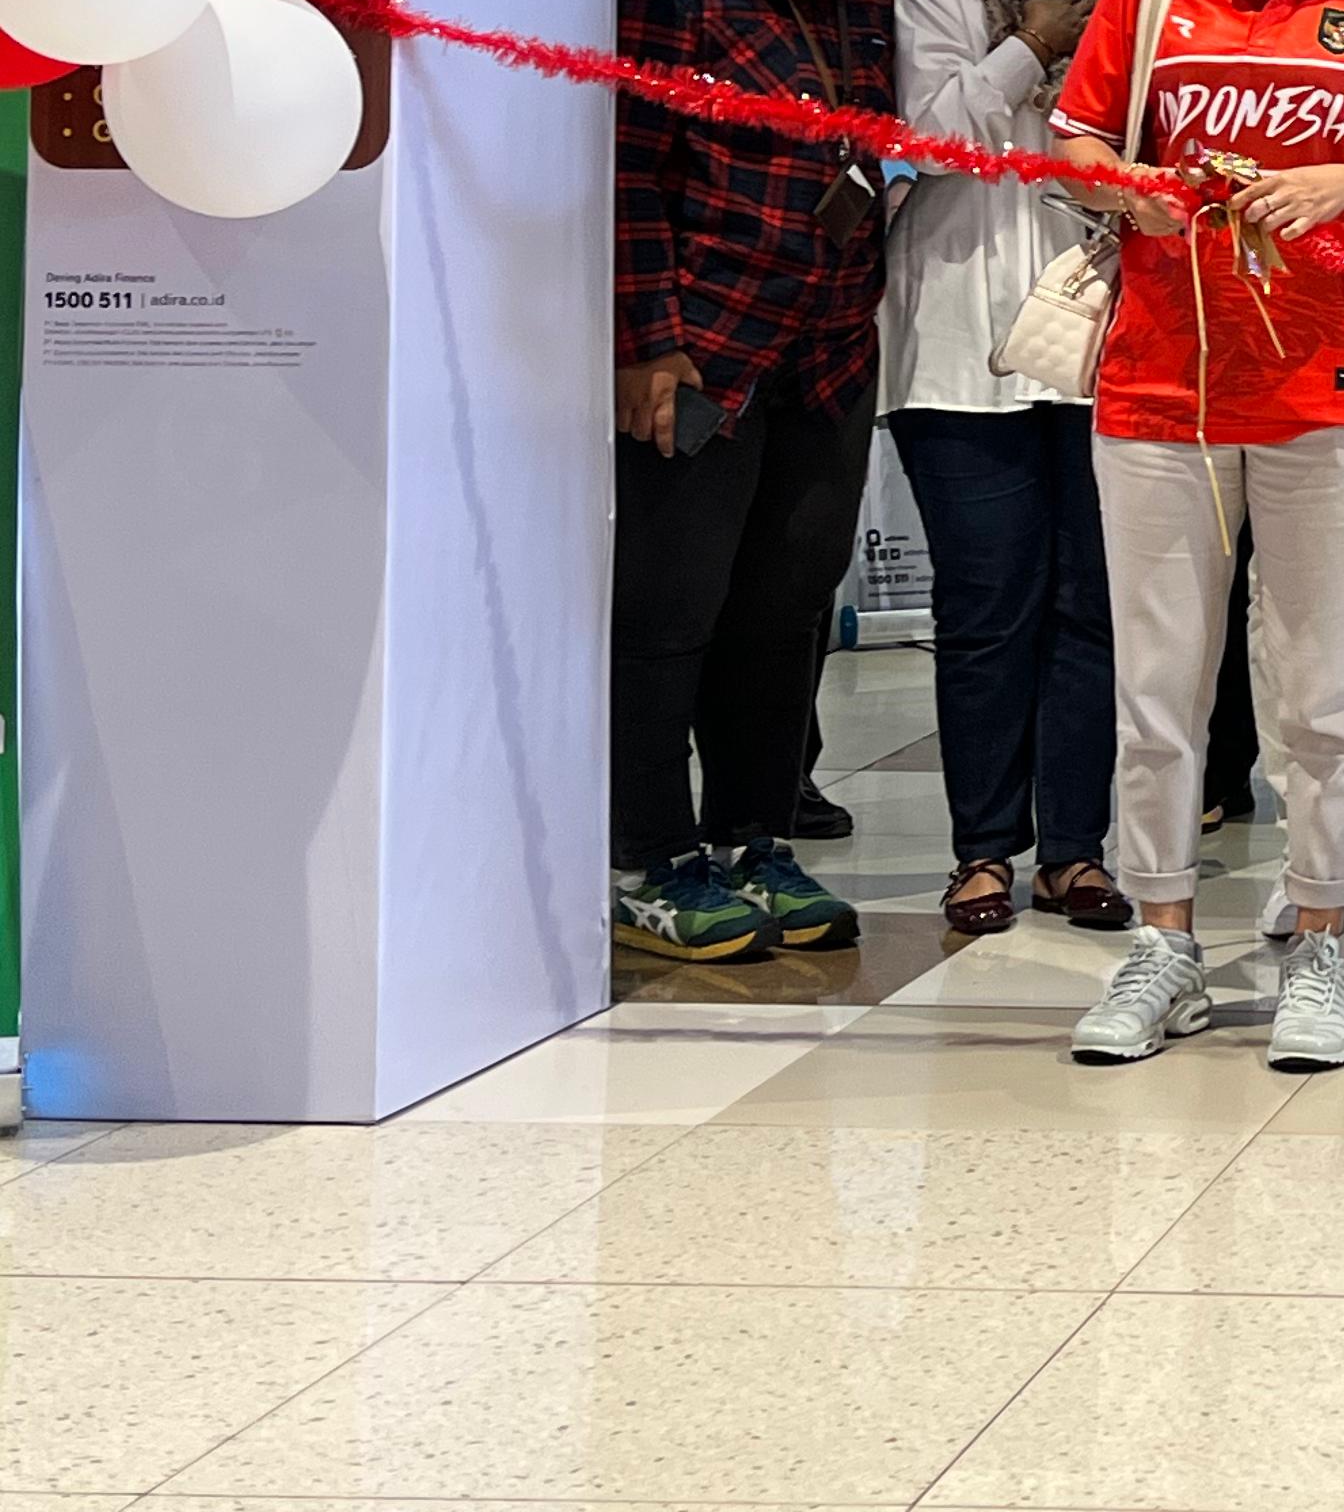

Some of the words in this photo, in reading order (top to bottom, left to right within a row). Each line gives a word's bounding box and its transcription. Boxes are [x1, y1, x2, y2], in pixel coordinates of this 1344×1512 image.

[44, 291, 94, 309] 1500
[98, 291, 133, 309] 511
[149, 294, 226, 307] adira.co.id
